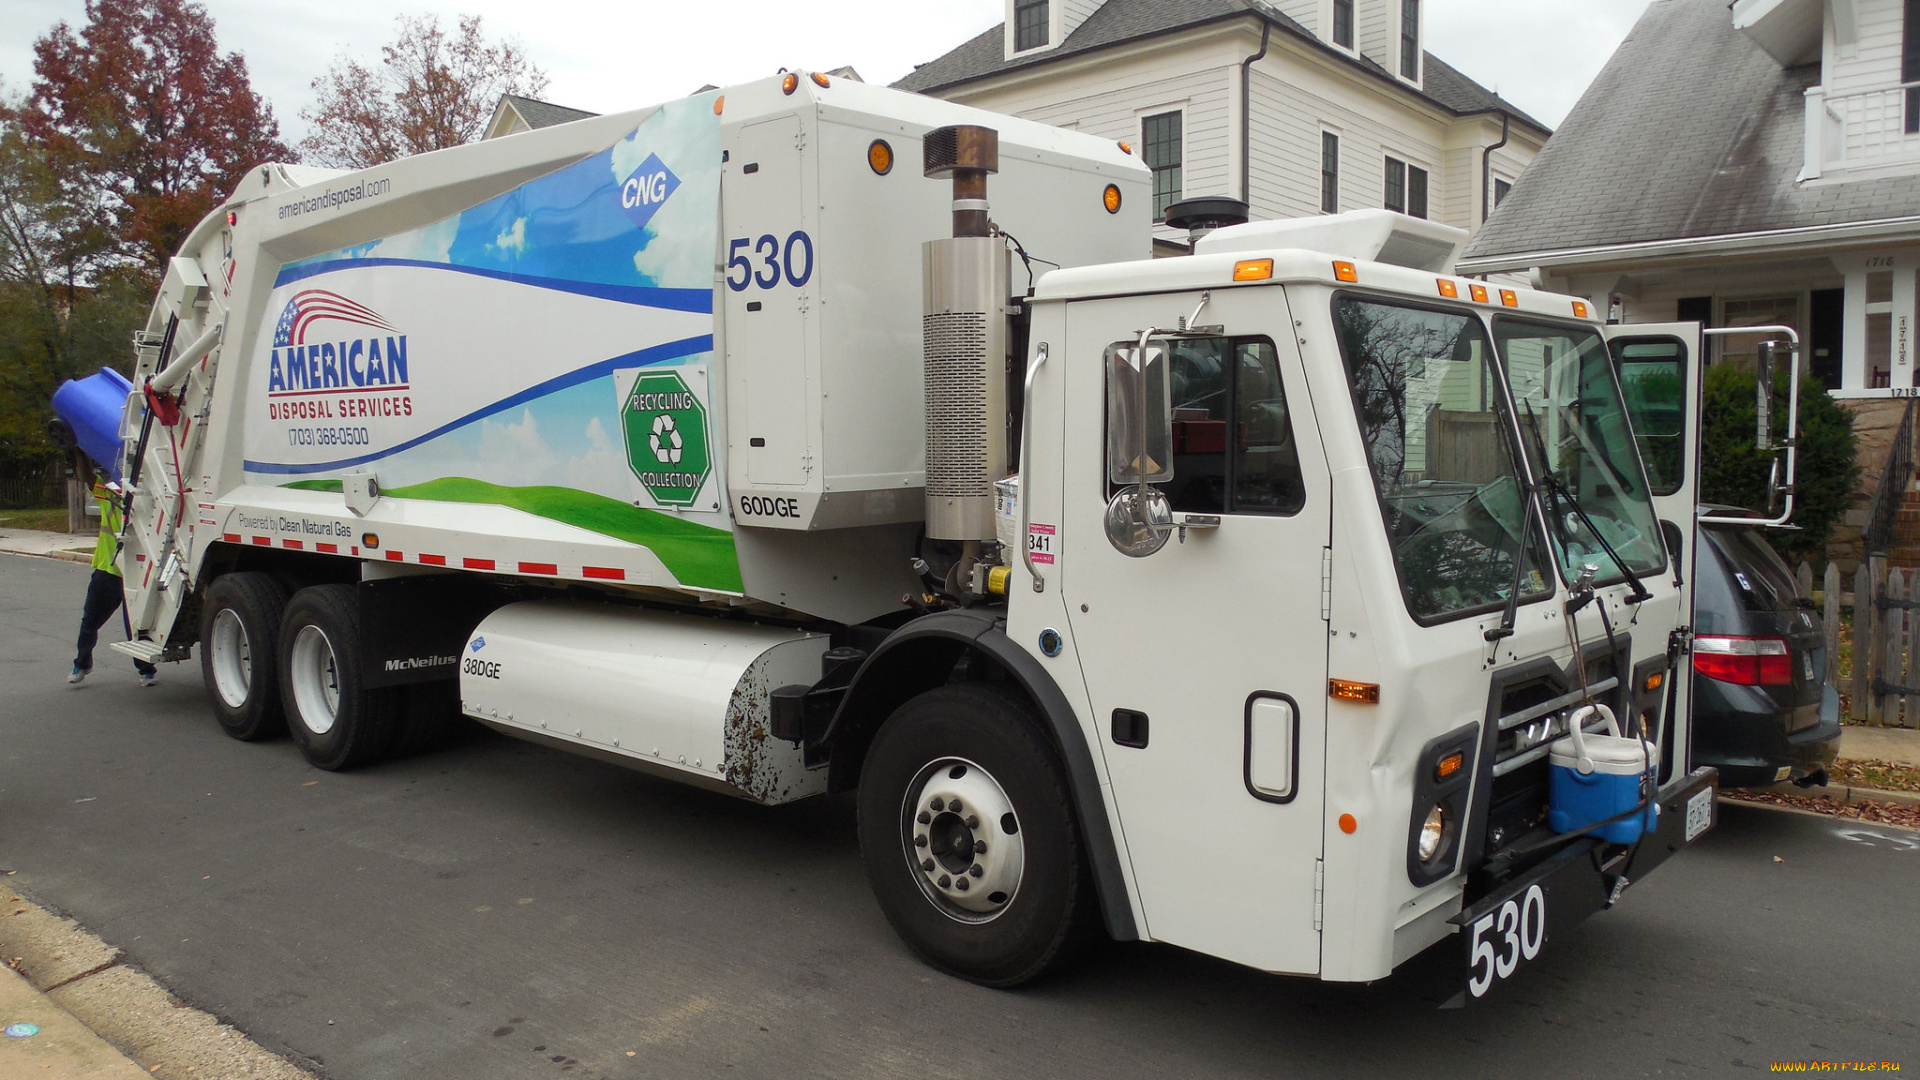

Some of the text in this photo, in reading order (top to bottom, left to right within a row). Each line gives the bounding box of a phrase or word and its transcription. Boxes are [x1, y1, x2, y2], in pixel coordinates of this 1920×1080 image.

[278, 178, 391, 220] americandisposal.com
[622, 171, 667, 209] CNG
[726, 230, 814, 292] 530
[268, 335, 409, 392] AMERICAN
[632, 391, 693, 411] RECYCLING
[1890, 388, 1918, 398] 1718
[269, 396, 413, 420] DISPOSAL SERVICES
[288, 426, 369, 446] (703) 368-0500
[642, 472, 701, 488] COLLECTION
[740, 495, 801, 518] 60DGE
[238, 513, 352, 537] Powered by Clean Natural Gas
[1028, 534, 1050, 552] 341
[384, 655, 457, 672] McNeilus
[463, 657, 501, 680] 38DGE
[1469, 884, 1545, 998] 530
